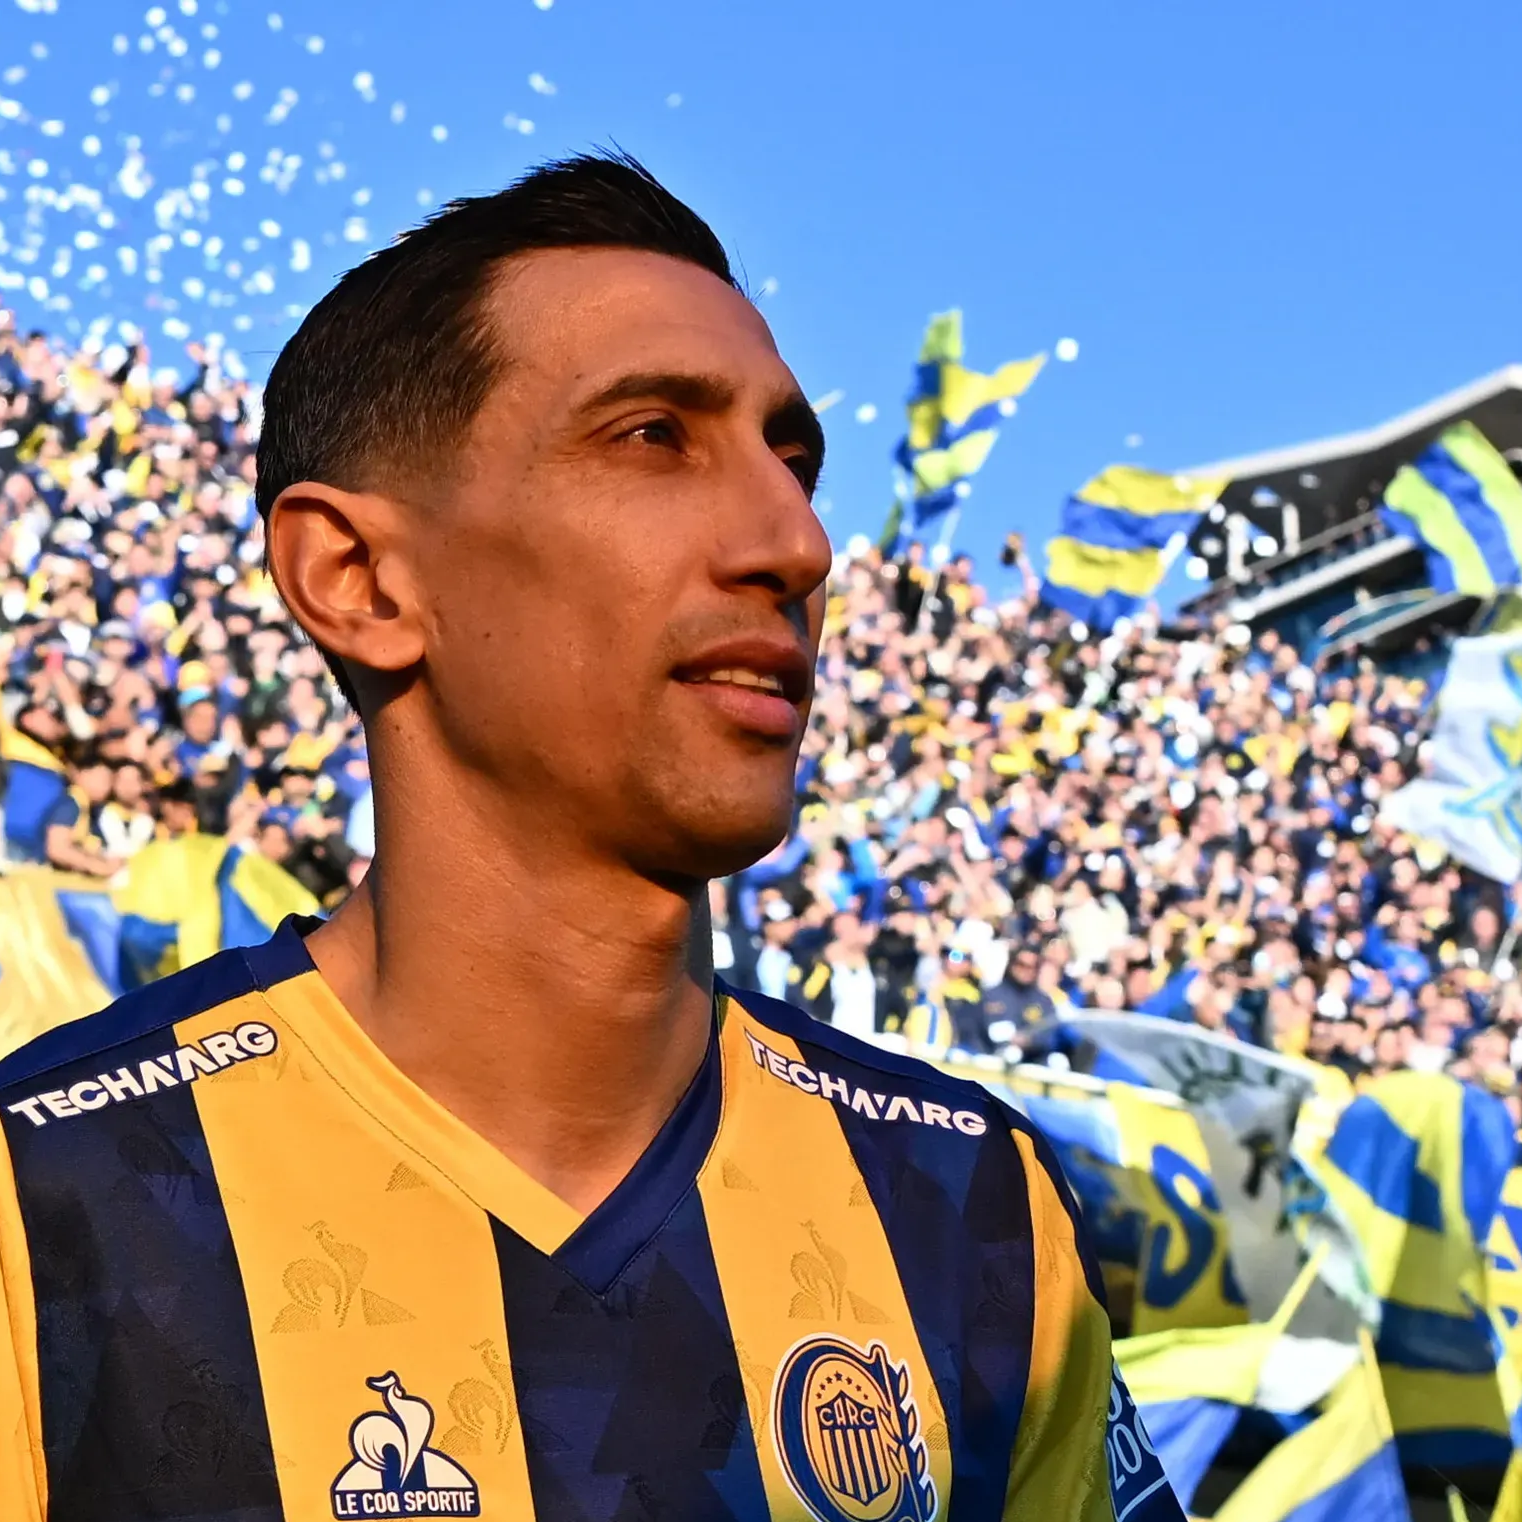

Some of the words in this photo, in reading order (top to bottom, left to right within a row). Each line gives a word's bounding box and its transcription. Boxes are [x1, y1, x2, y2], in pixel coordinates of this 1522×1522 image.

[819, 1397, 875, 1426] CARC
[335, 1493, 359, 1515] LE
[362, 1491, 401, 1514] COQ
[403, 1491, 476, 1513] SPORTIF
